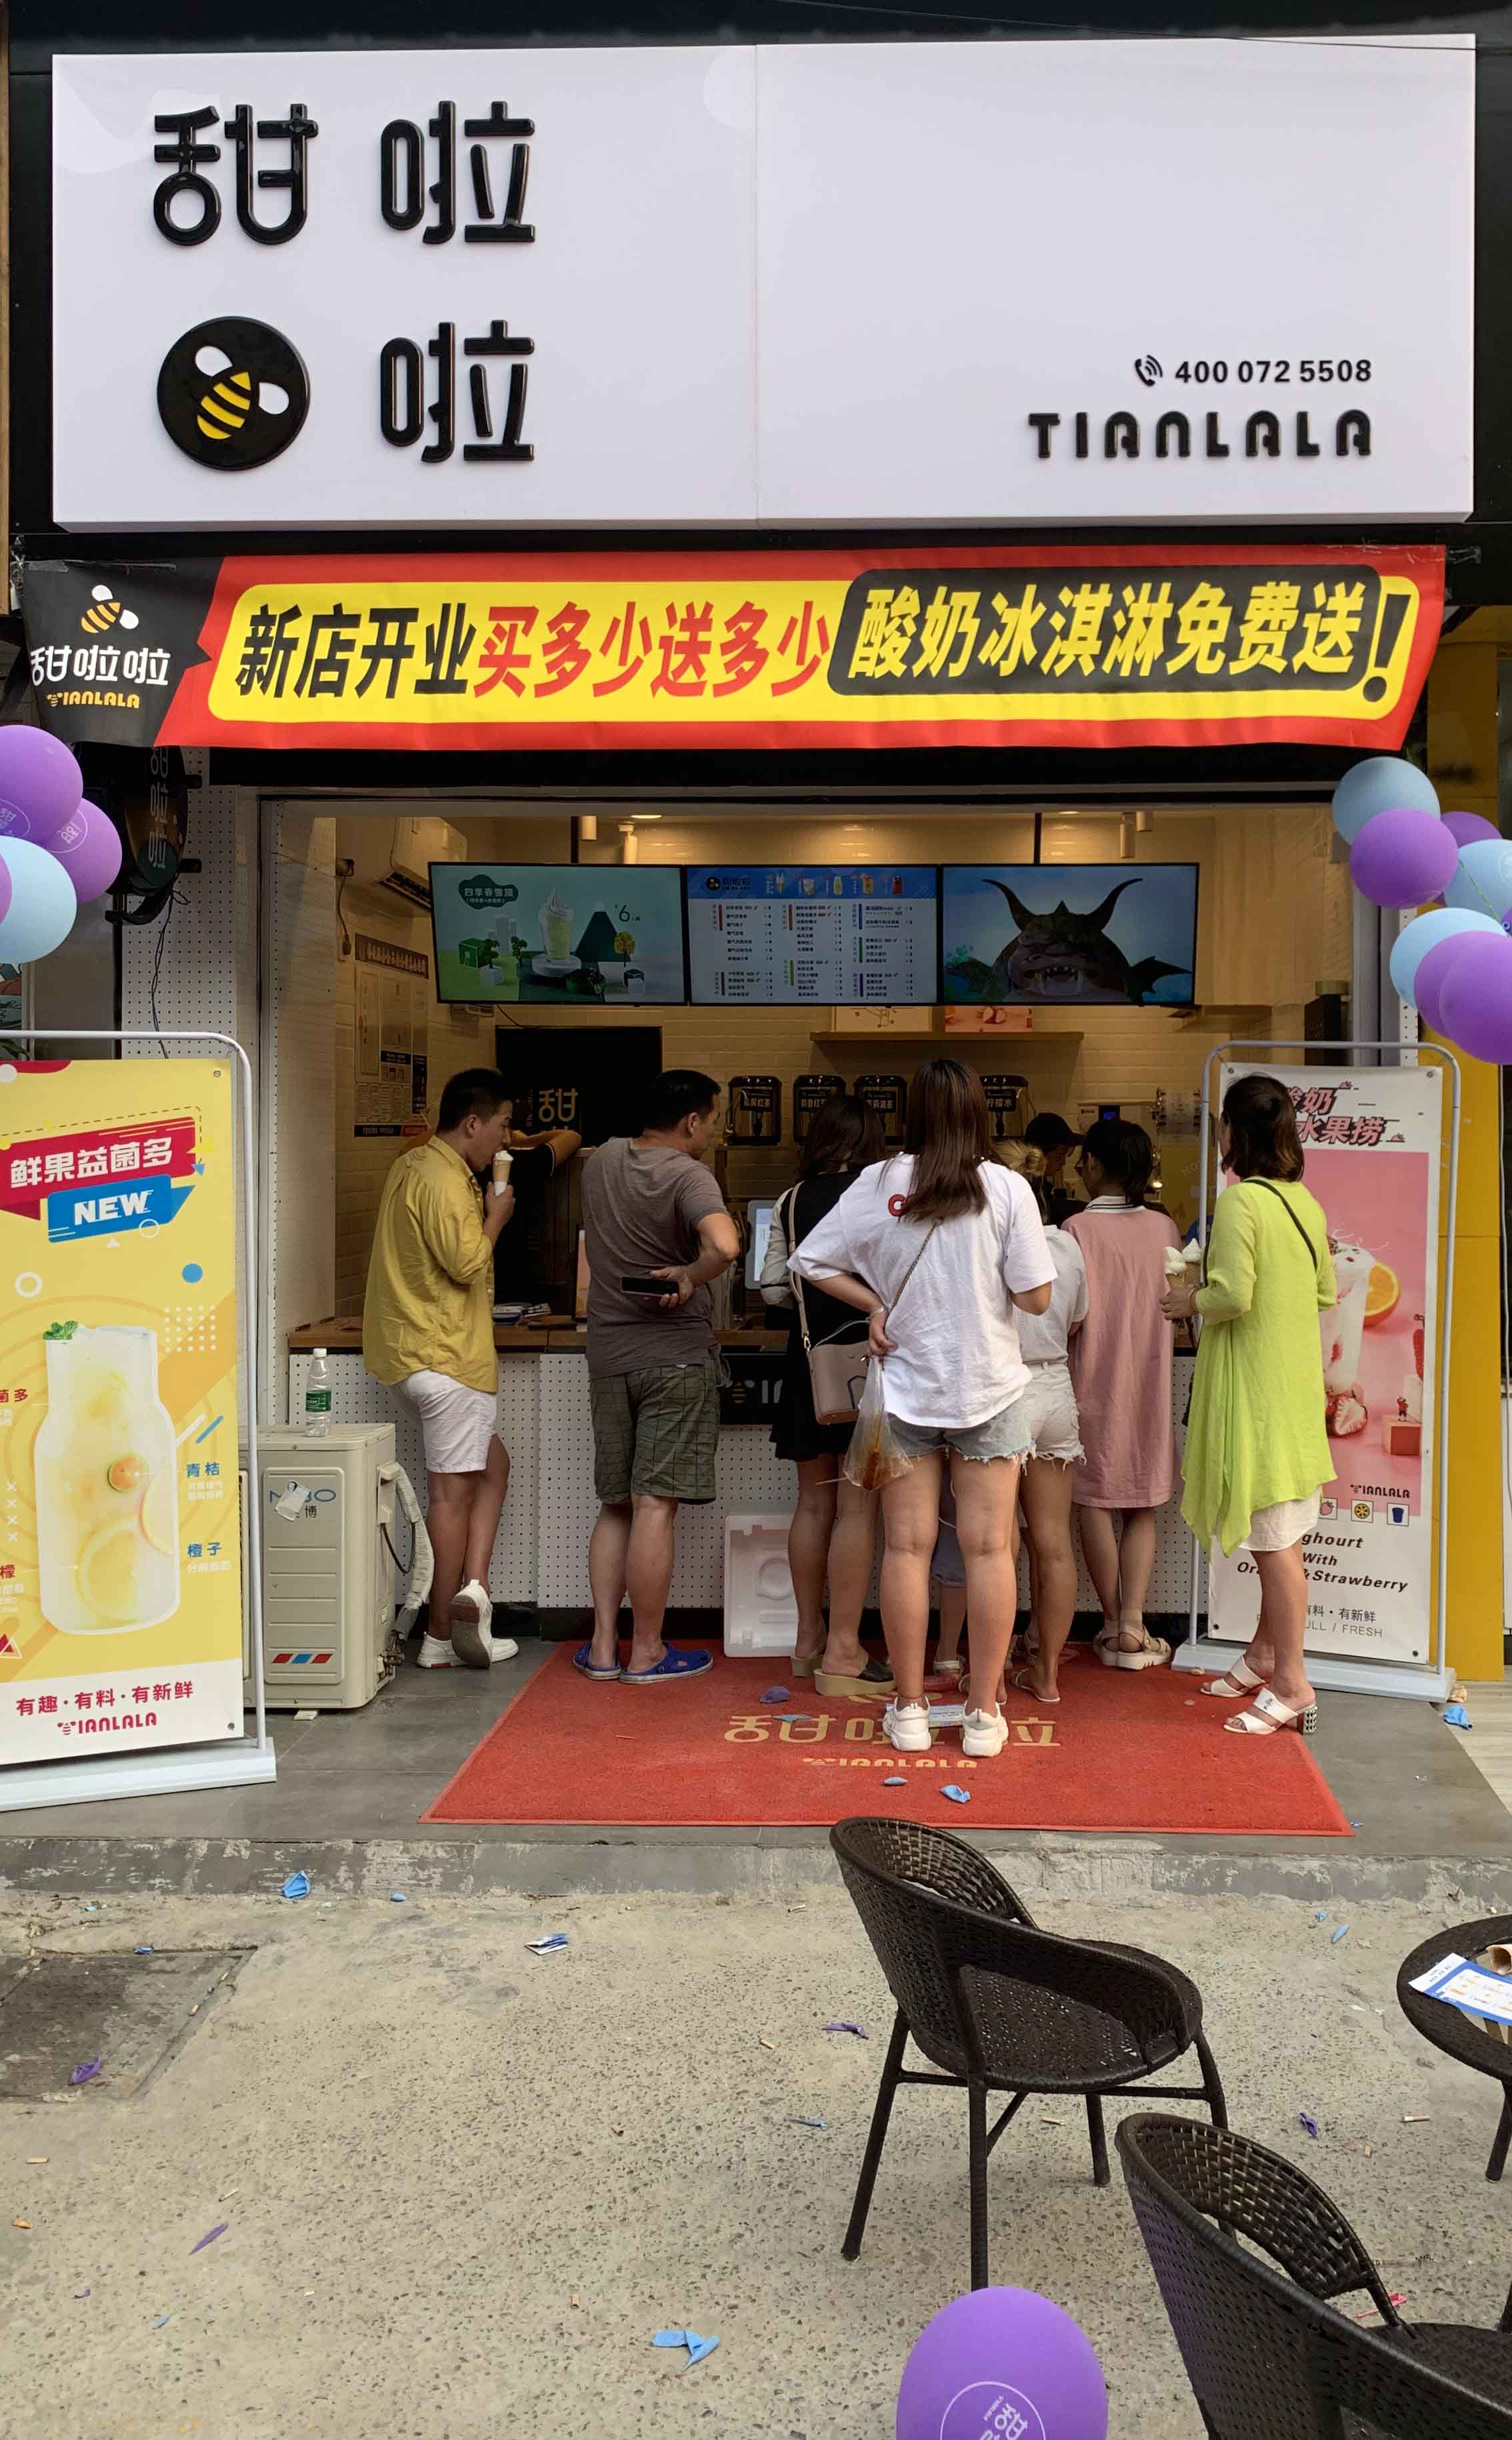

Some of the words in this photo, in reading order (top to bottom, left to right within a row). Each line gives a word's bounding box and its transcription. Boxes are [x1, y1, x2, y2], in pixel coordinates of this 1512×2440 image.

[1175, 360, 1229, 383] 400
[1238, 360, 1291, 383] 072
[1299, 359, 1372, 383] 5508
[380, 320, 536, 463] 啦
[1028, 409, 1371, 459] TIANLALA
[31, 645, 171, 687] 甜啦啦
[11, 1136, 173, 1189] 鲜果益菌多
[74, 1189, 155, 1226] NEW
[186, 1461, 221, 1478] 青桔
[187, 1541, 223, 1558] 橙子
[1301, 1532, 1365, 1549] ghourt
[1302, 1551, 1339, 1567] With
[1312, 1570, 1409, 1593] Strawberry
[1342, 1624, 1383, 1638] FRESH
